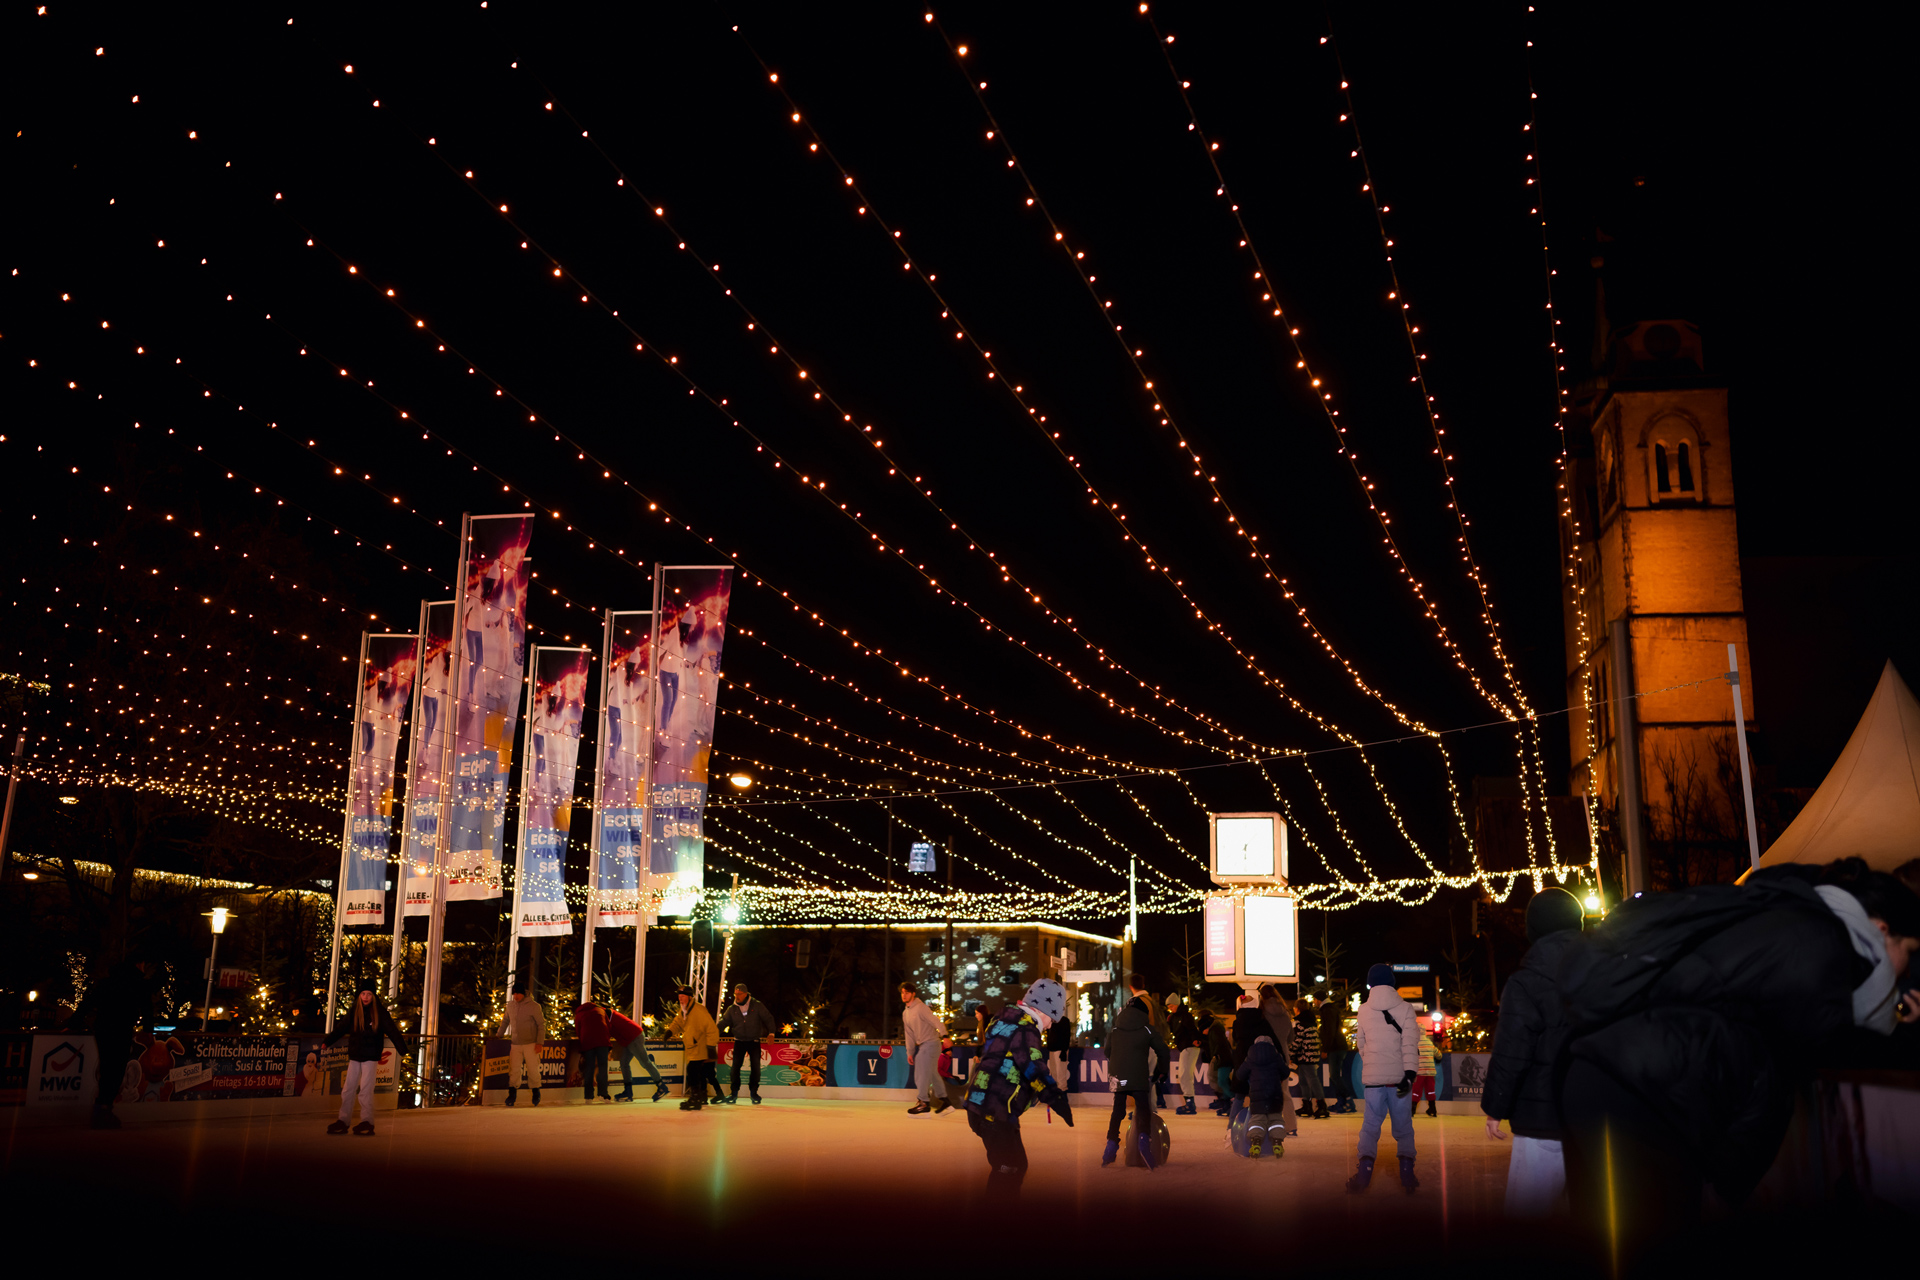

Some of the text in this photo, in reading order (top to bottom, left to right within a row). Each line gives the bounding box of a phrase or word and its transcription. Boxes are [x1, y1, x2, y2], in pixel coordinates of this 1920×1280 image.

[196, 1044, 285, 1058] Schlittschuhlaufen
[235, 1060, 254, 1071] Susi
[255, 1060, 263, 1071] &
[265, 1060, 283, 1071] Tino
[40, 1076, 82, 1091] MWG
[213, 1076, 282, 1089] freitags 16-18 Uhr
[375, 1075, 393, 1084] rocken
